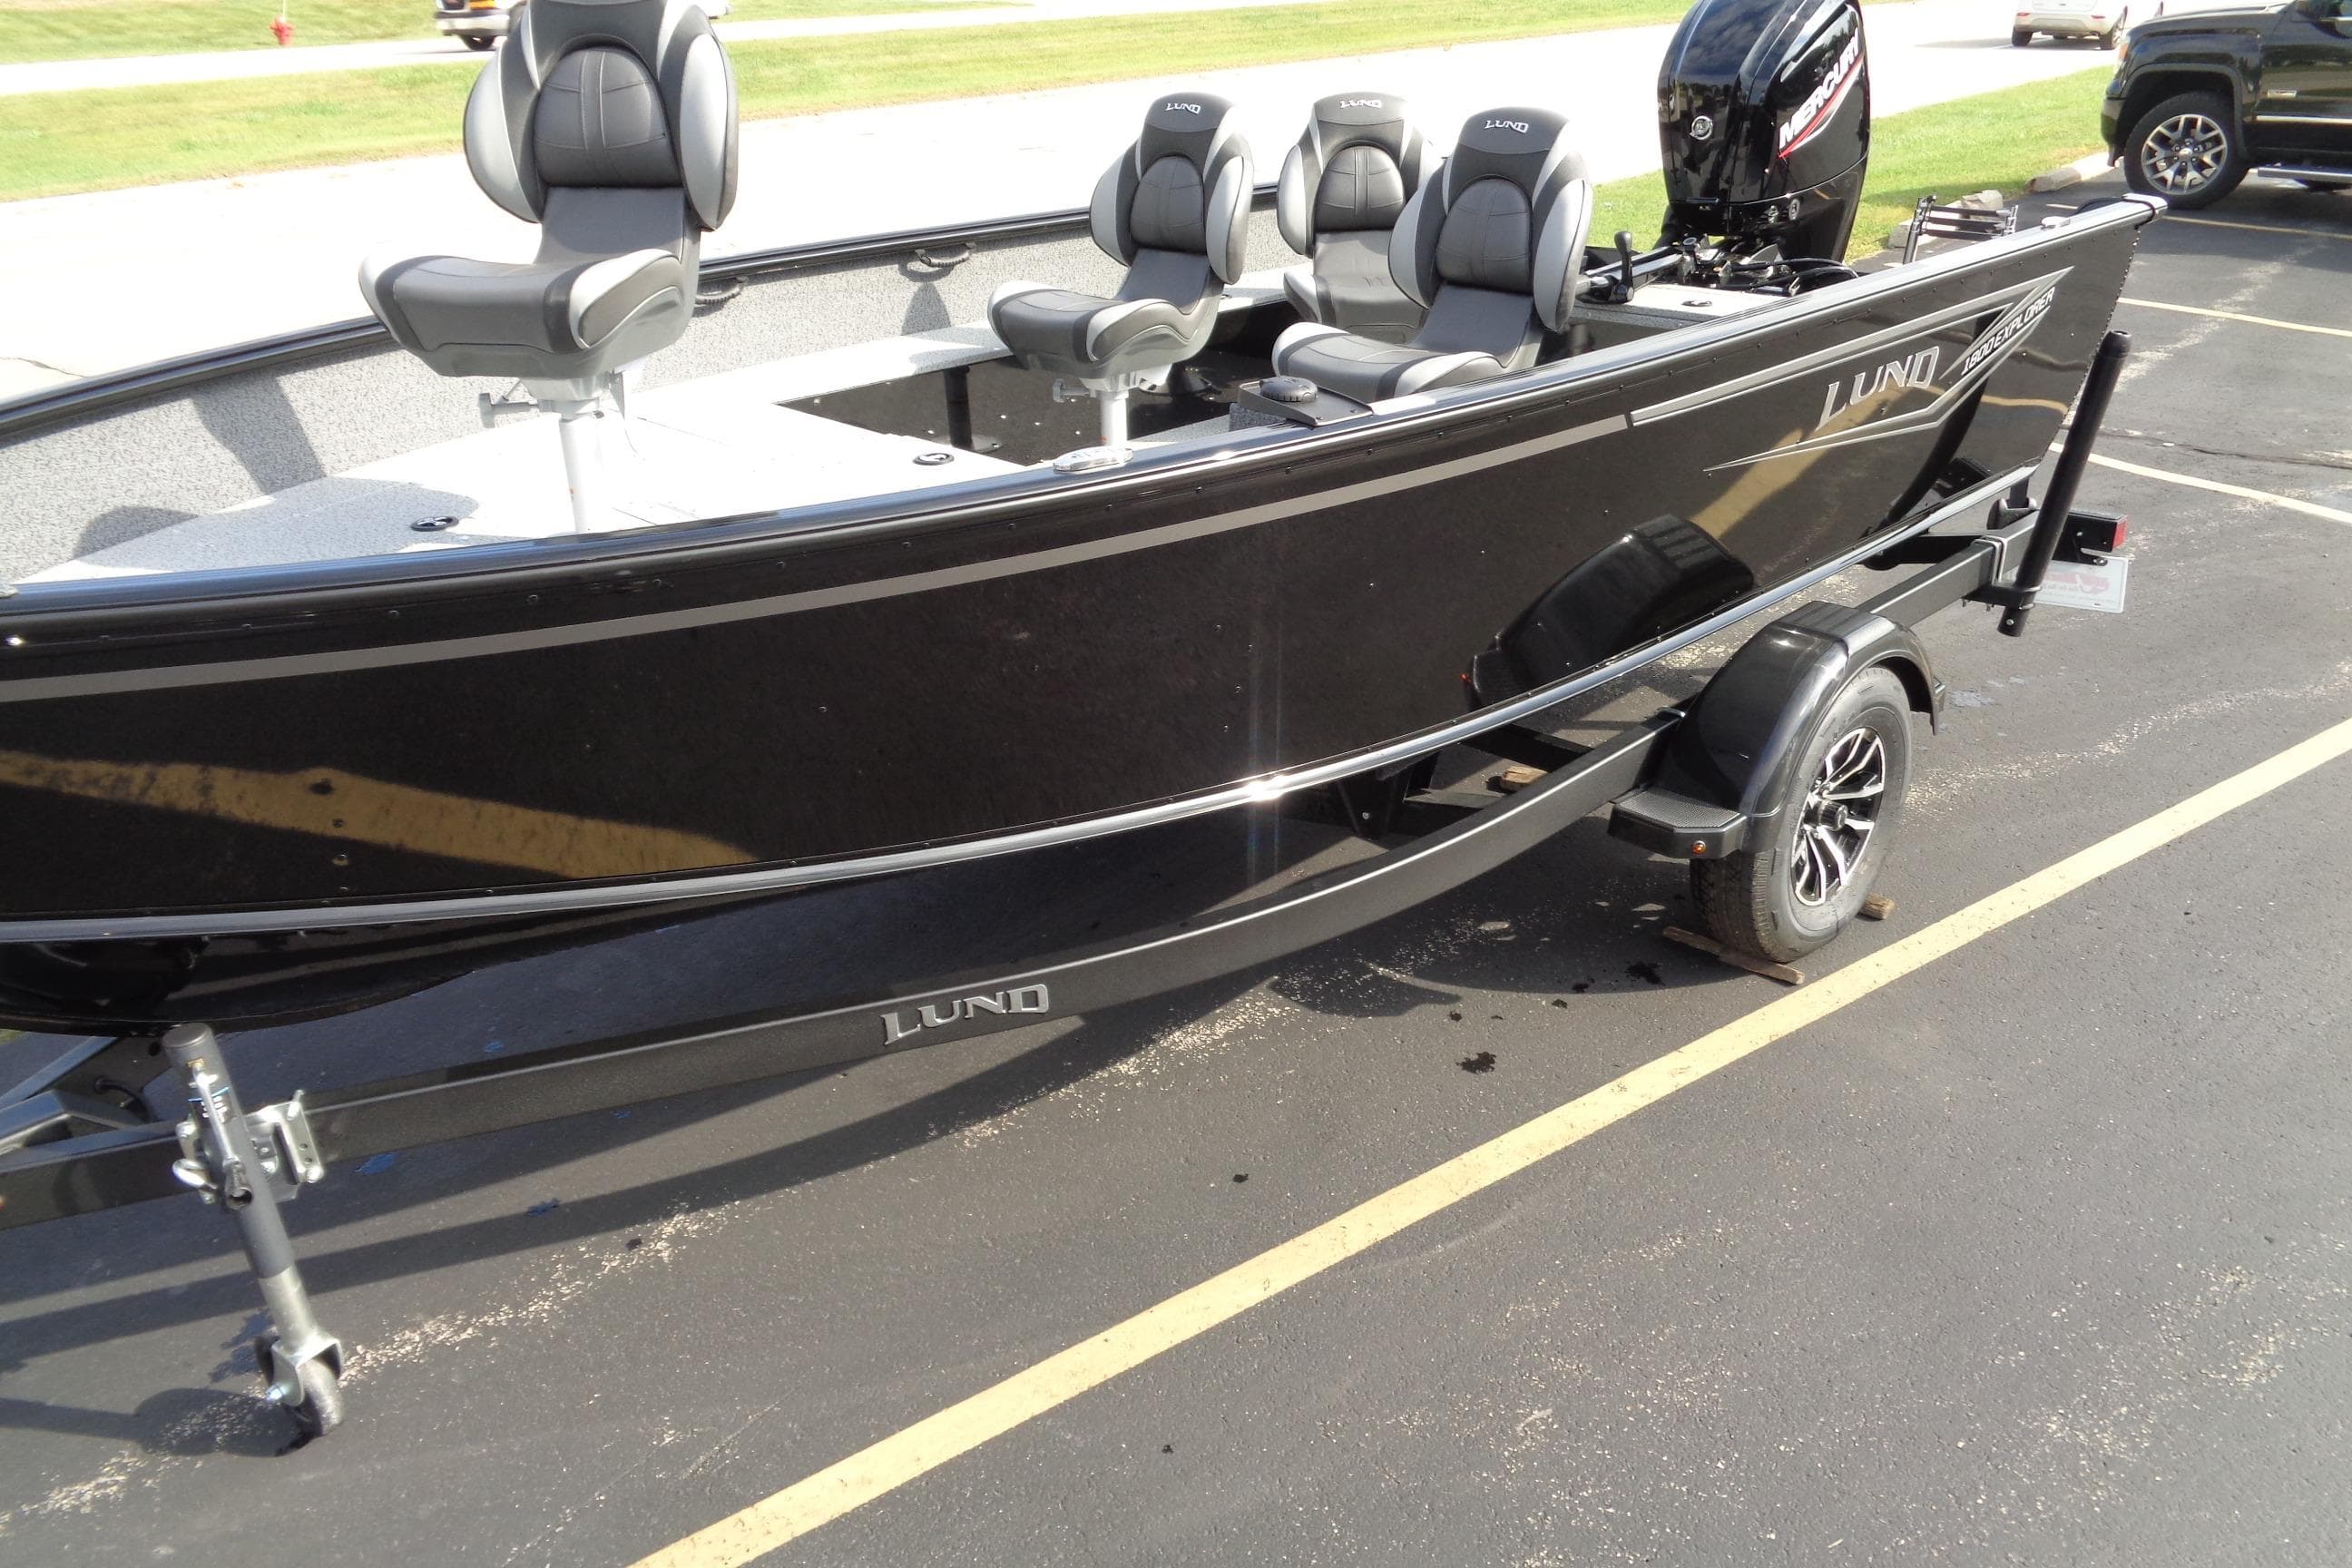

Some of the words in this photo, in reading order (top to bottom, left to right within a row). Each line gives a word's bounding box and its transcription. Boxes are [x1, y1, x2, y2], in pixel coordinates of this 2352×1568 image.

[1165, 103, 1201, 114] LUND
[1779, 26, 1859, 150] MERCURY
[1484, 120, 1529, 133] LUND
[1993, 286, 2056, 349] EXPLORER
[1815, 346, 1940, 431] LUND
[880, 984, 1050, 1045] LUND
